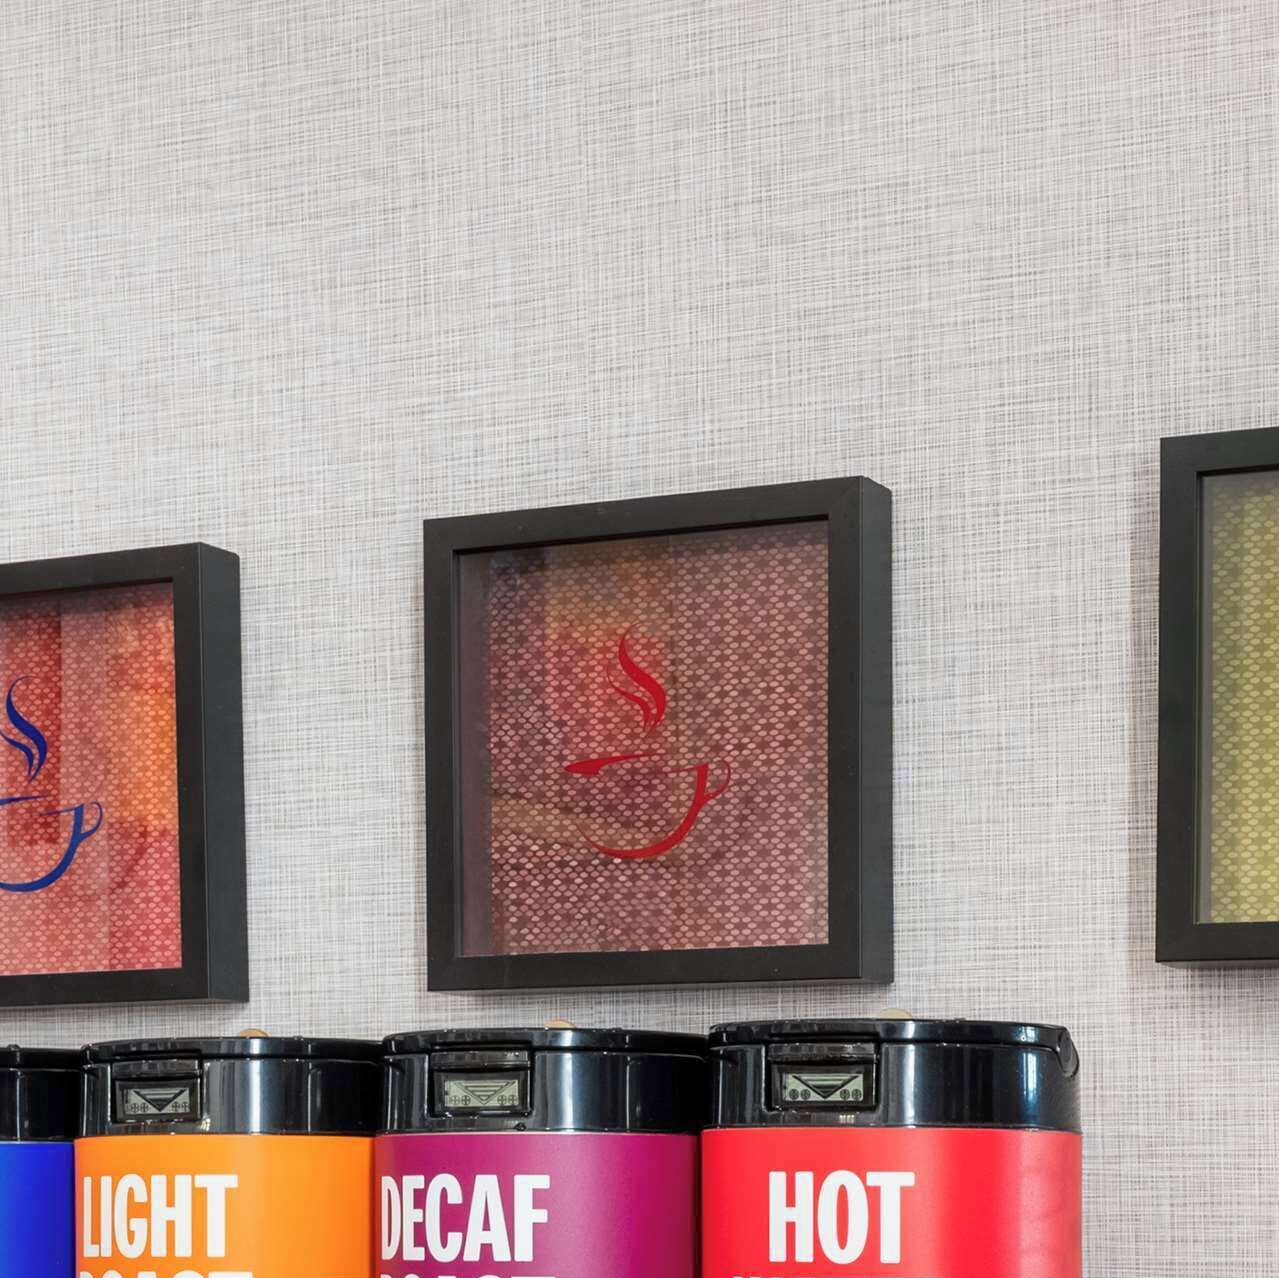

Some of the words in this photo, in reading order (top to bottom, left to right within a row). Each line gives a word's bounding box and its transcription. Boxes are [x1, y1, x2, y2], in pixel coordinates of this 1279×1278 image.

[82, 1173, 238, 1259] LIGHT
[380, 1173, 551, 1263] DECAF
[768, 1170, 915, 1264] HOT
